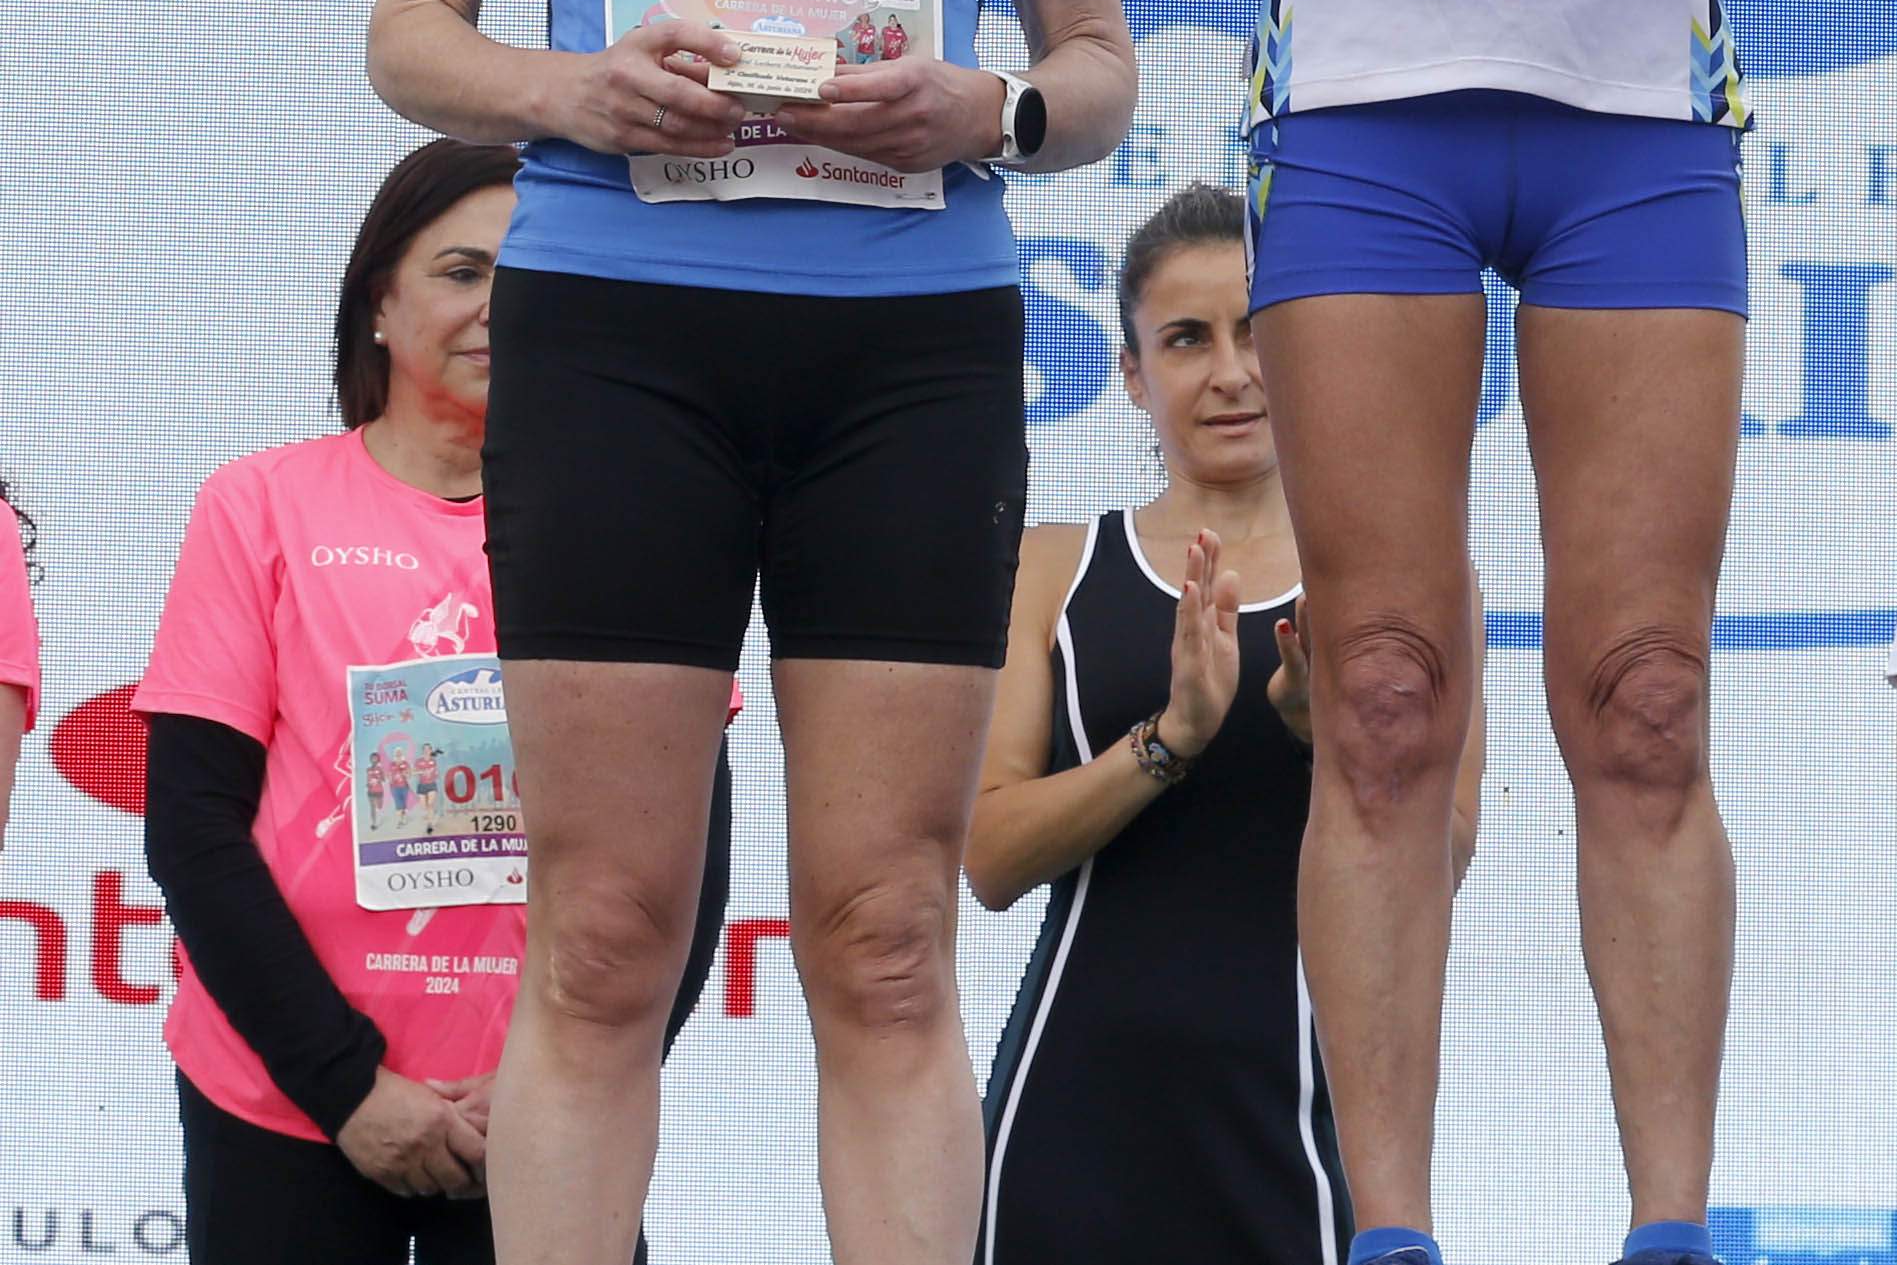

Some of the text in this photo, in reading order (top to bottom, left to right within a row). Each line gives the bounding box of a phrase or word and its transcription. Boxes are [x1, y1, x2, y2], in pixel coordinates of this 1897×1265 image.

[740, 42, 775, 55] Carrera
[790, 45, 825, 65] Mujer
[740, 124, 762, 140] DE
[822, 162, 905, 189] Santander
[311, 545, 419, 570] OYSHO
[364, 689, 409, 705] SUMA
[471, 815, 517, 833] 1290
[396, 840, 459, 857] CARRERA
[461, 838, 478, 853] DE
[481, 837, 500, 852] LA
[387, 867, 475, 893] OYSHO
[366, 952, 519, 975] CARRERA DE LA MUJER
[425, 976, 461, 995] 2024
